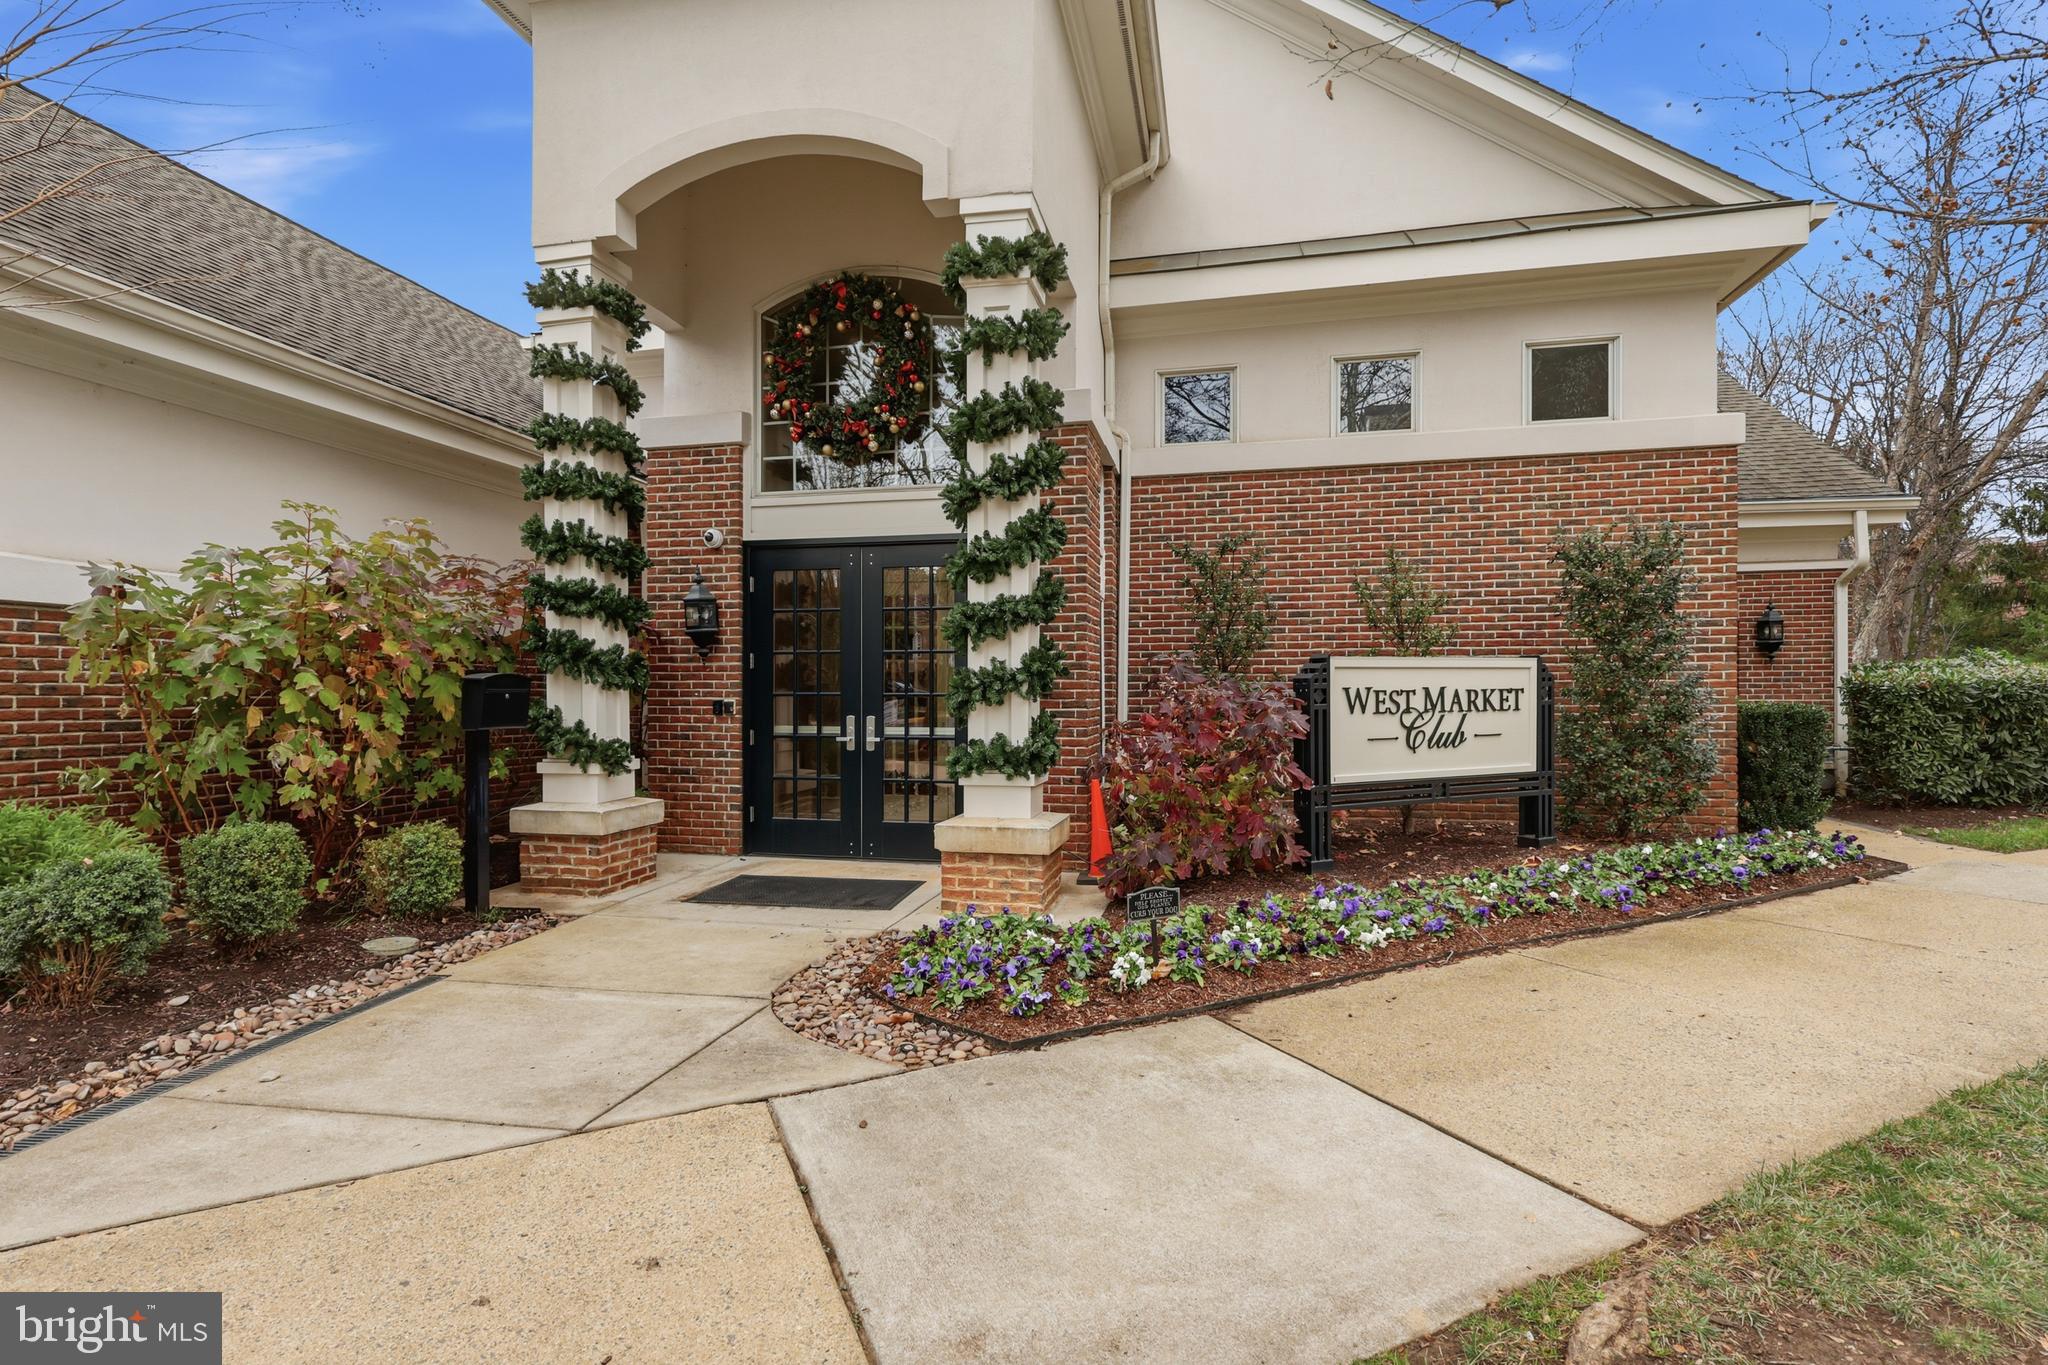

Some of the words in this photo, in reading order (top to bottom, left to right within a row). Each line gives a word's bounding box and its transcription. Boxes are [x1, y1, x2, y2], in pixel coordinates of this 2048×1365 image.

[1342, 686, 1416, 716] WEST
[1422, 686, 1525, 714] MARKET
[1399, 706, 1467, 754] Club
